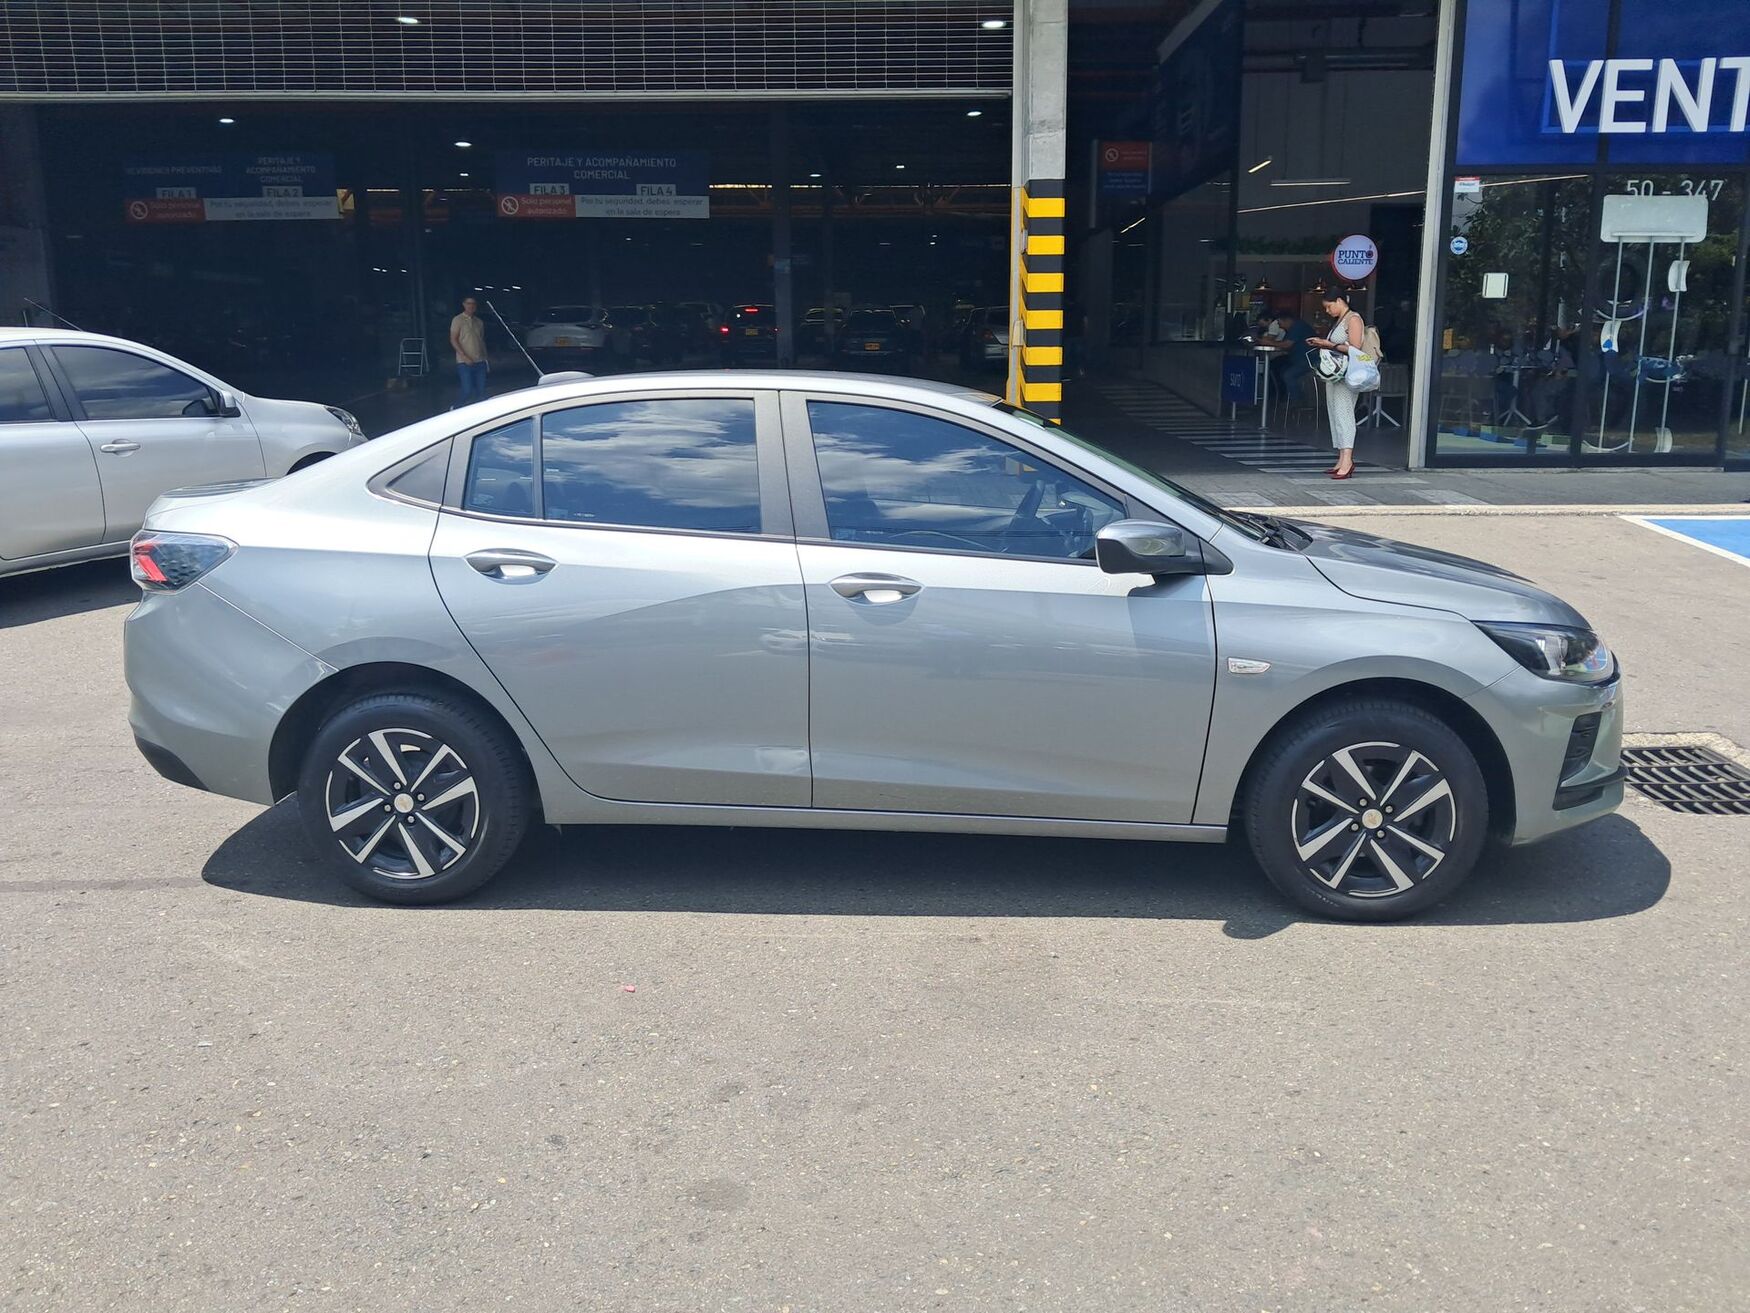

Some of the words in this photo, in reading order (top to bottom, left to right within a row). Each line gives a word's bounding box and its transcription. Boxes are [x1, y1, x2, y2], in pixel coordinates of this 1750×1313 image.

[1548, 57, 1750, 133] VENT
[527, 157, 575, 167] PERITAJE
[577, 157, 584, 167] Y
[585, 155, 677, 168] ACOMPAÑAMIENTO
[574, 170, 632, 180] COMERCIAL
[267, 188, 290, 198] FILA
[292, 188, 299, 198] 2
[534, 185, 557, 195] FILA
[559, 185, 566, 195] 3
[640, 185, 664, 196] FILA
[665, 185, 673, 196] 4
[1338, 250, 1373, 258] PUNTO
